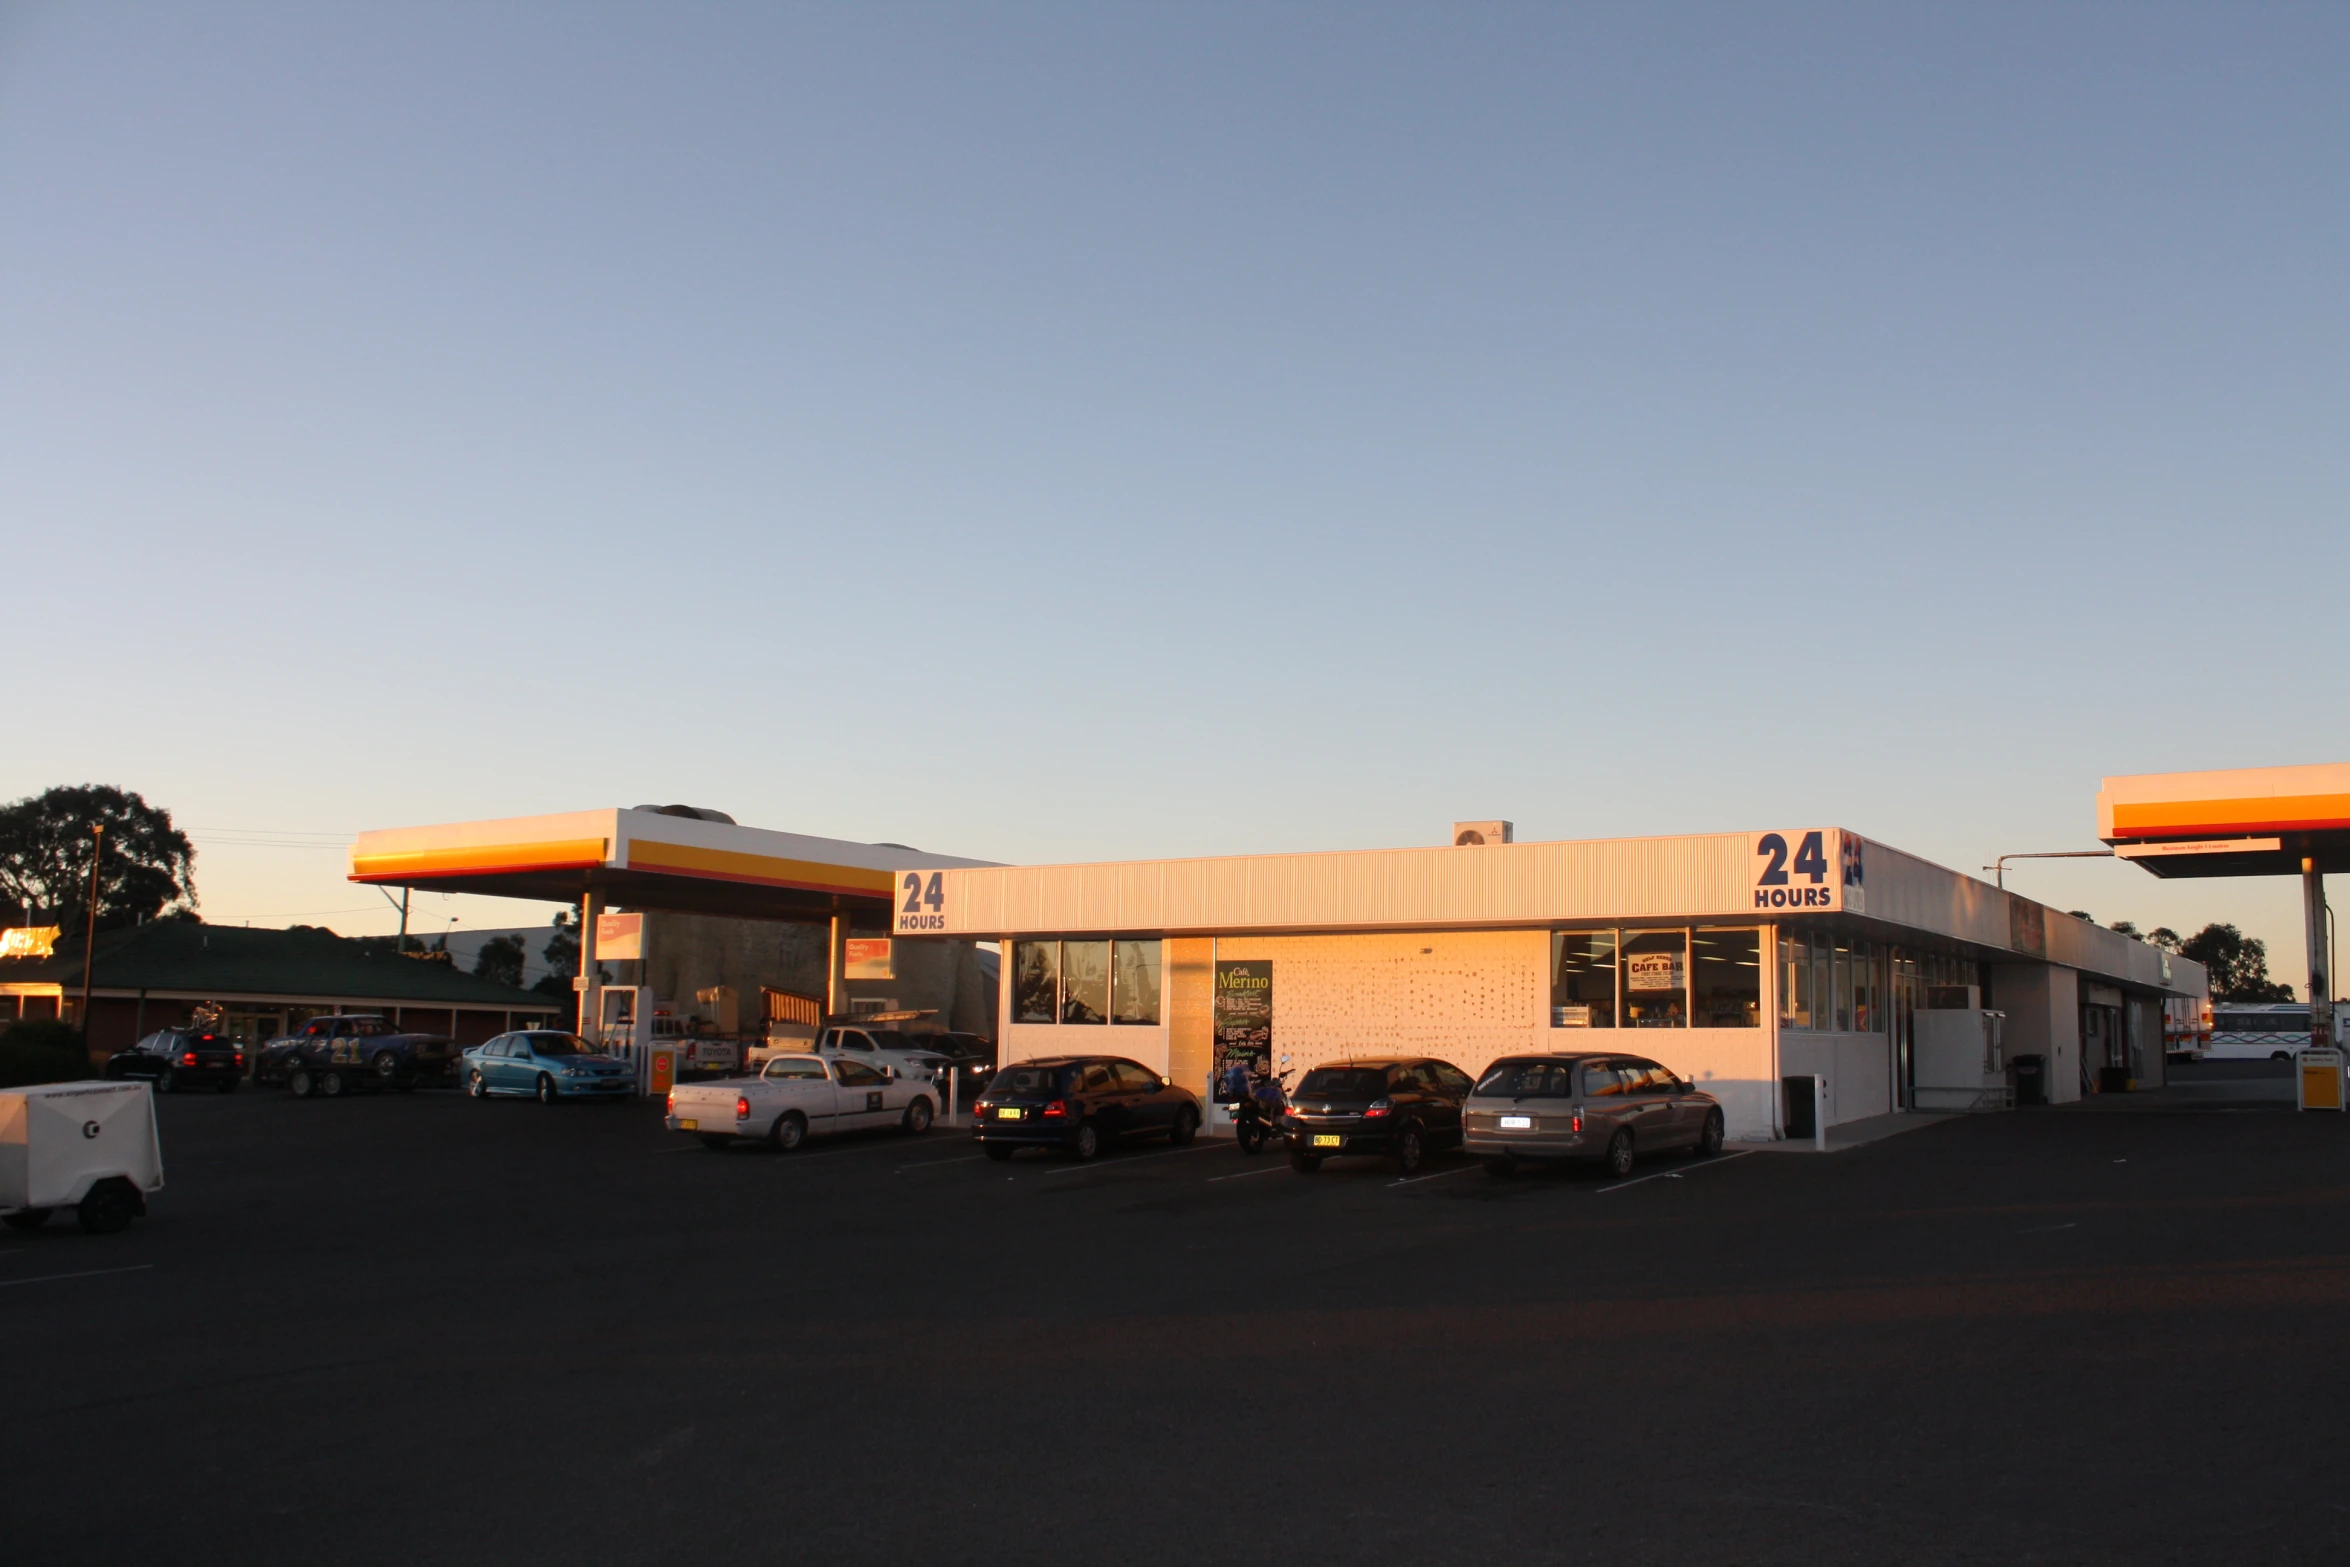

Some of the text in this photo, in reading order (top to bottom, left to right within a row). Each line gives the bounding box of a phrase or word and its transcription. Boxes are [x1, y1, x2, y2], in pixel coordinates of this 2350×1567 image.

[1757, 831, 1827, 886] 24
[902, 872, 944, 912] 24
[1754, 887, 1831, 908] HOURS
[900, 915, 945, 930] HOURS
[1632, 961, 1684, 973] CAFE BAR
[1218, 972, 1269, 989] Merino
[331, 1037, 363, 1064] 21
[702, 1047, 731, 1057] TOYOTA
